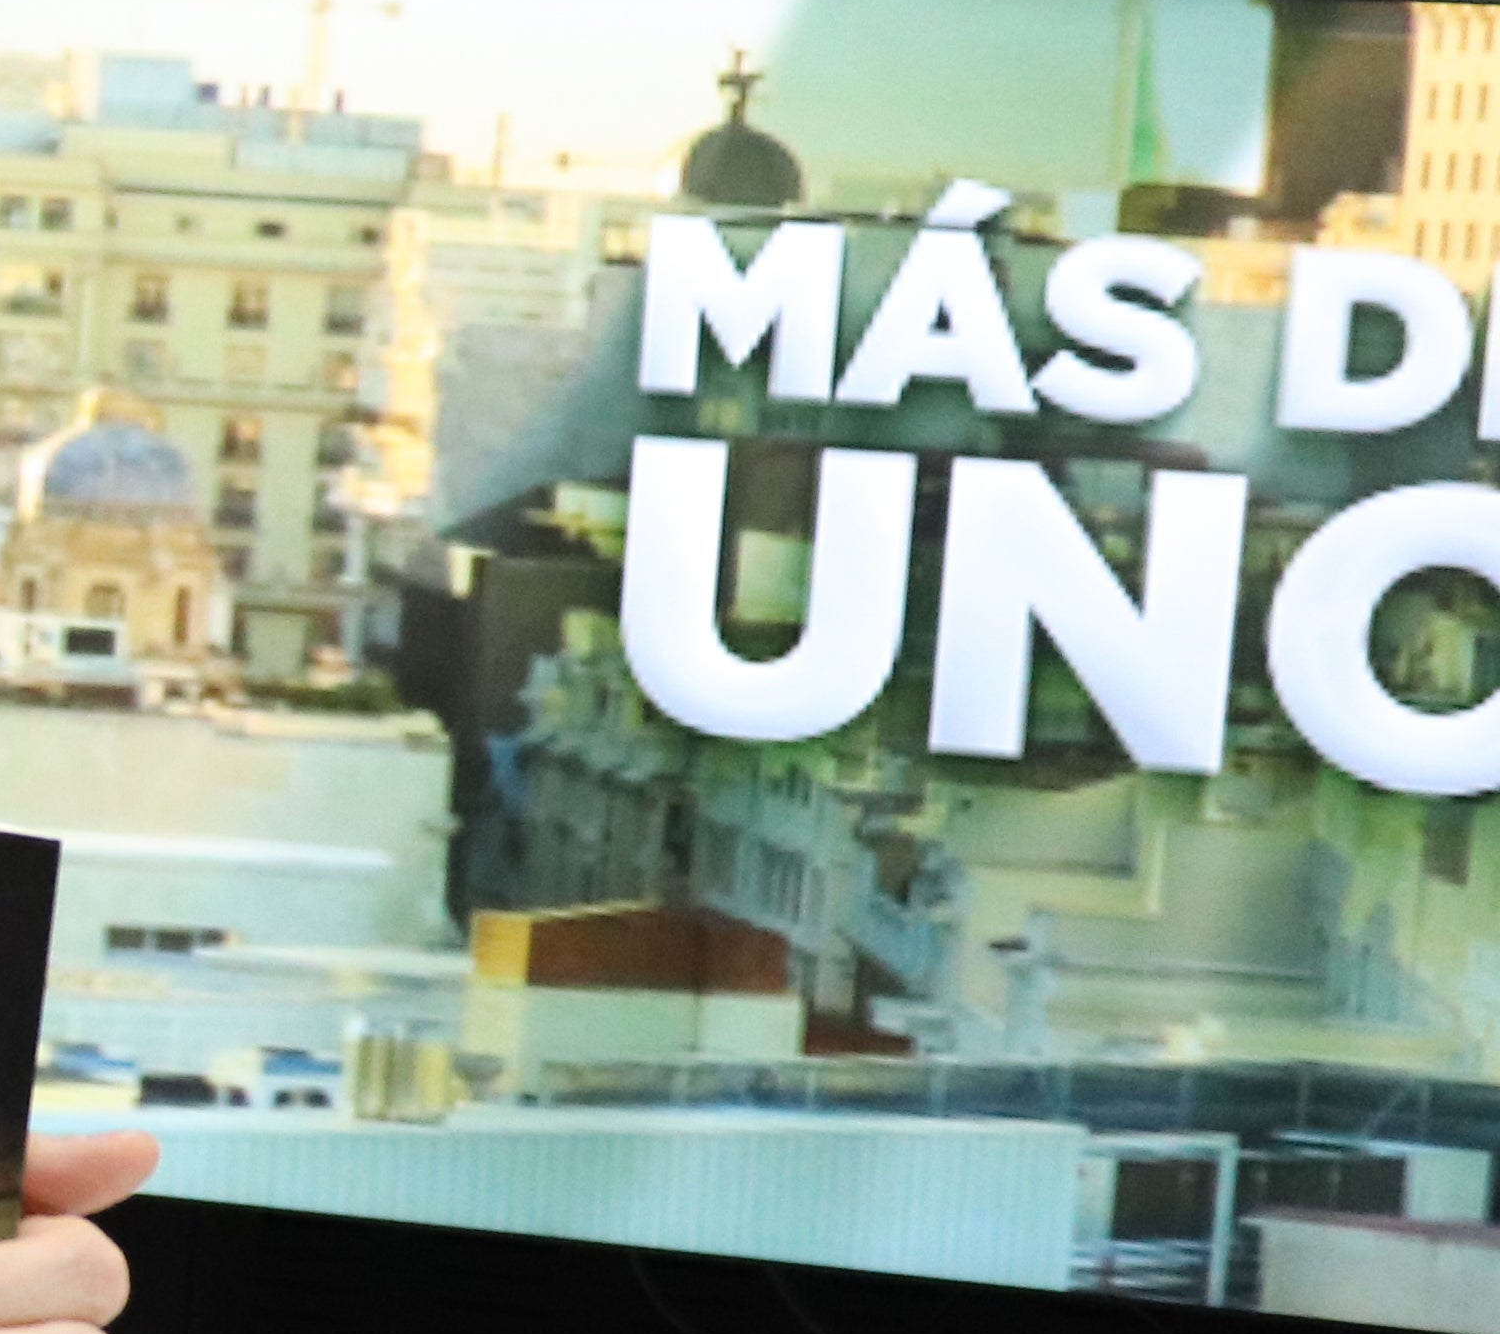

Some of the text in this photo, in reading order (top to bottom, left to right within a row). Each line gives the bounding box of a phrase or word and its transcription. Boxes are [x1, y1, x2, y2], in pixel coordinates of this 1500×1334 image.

[637, 177, 1500, 442] MÁS D
[620, 432, 1500, 797] UNO
